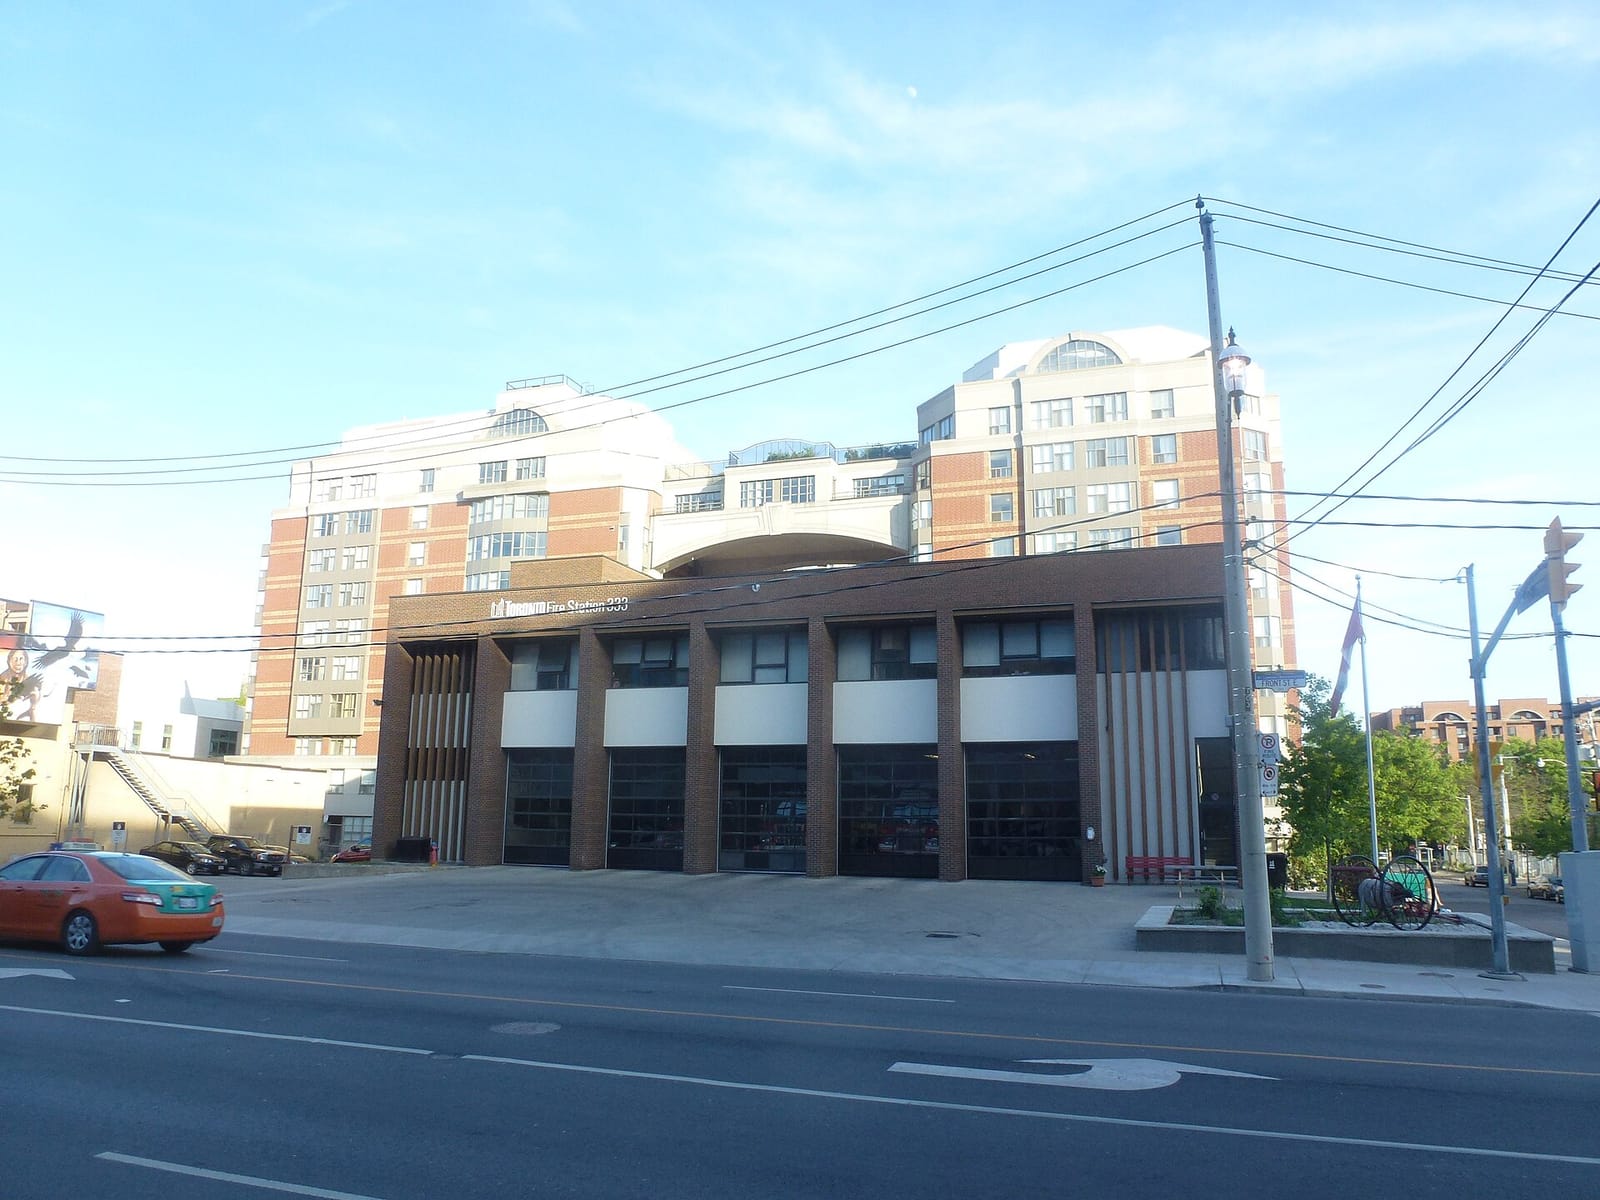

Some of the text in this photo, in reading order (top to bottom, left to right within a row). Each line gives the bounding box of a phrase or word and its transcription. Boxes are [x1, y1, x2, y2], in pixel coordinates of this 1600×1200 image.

[546, 601, 565, 615] Fire
[567, 599, 605, 613] Station
[606, 597, 628, 611] 333
